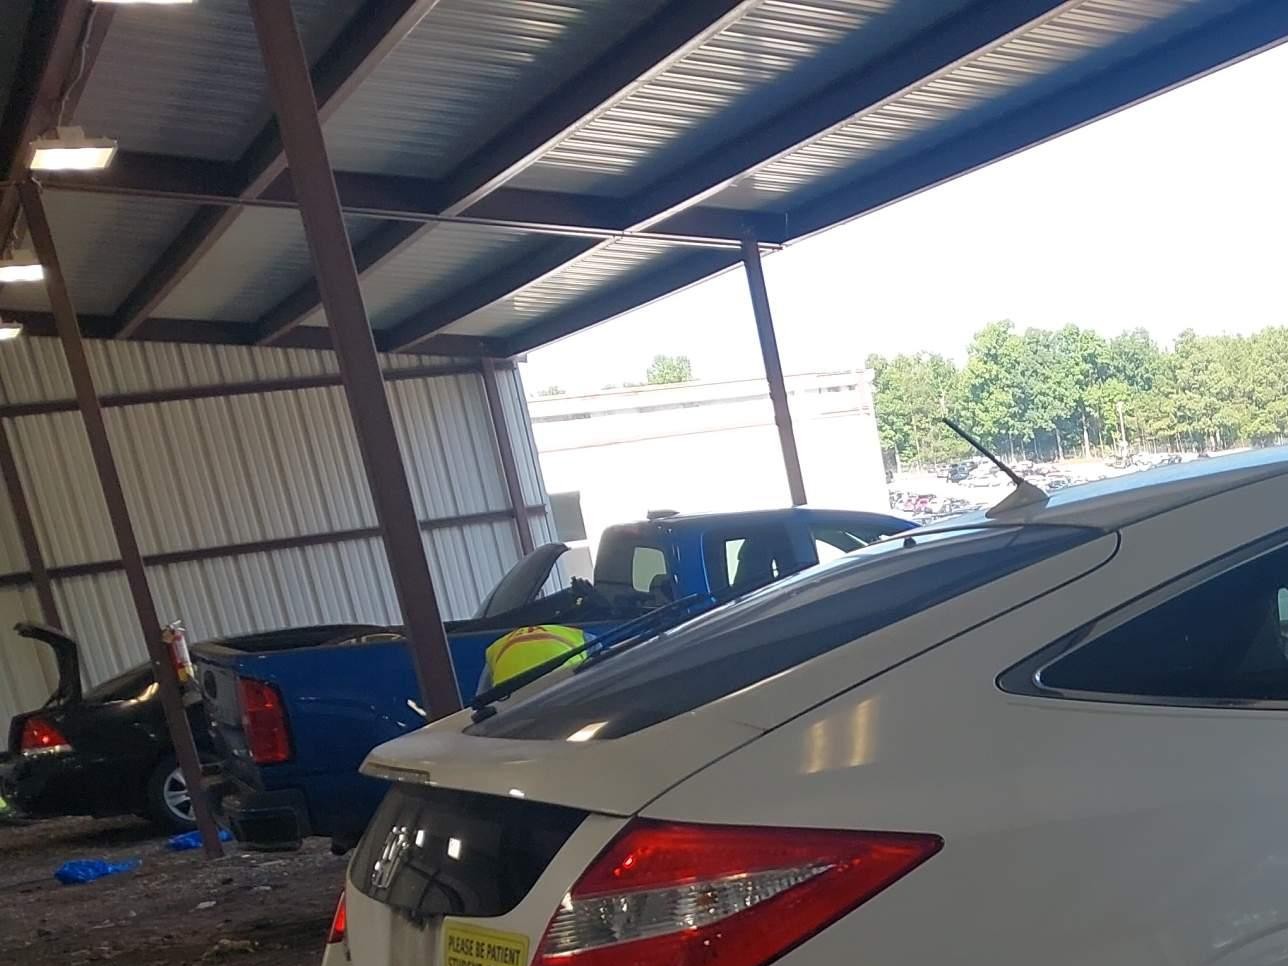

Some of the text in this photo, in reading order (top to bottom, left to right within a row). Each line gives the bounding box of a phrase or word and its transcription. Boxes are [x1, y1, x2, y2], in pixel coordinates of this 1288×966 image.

[448, 935, 520, 966] PLEASE BE PATIENT
